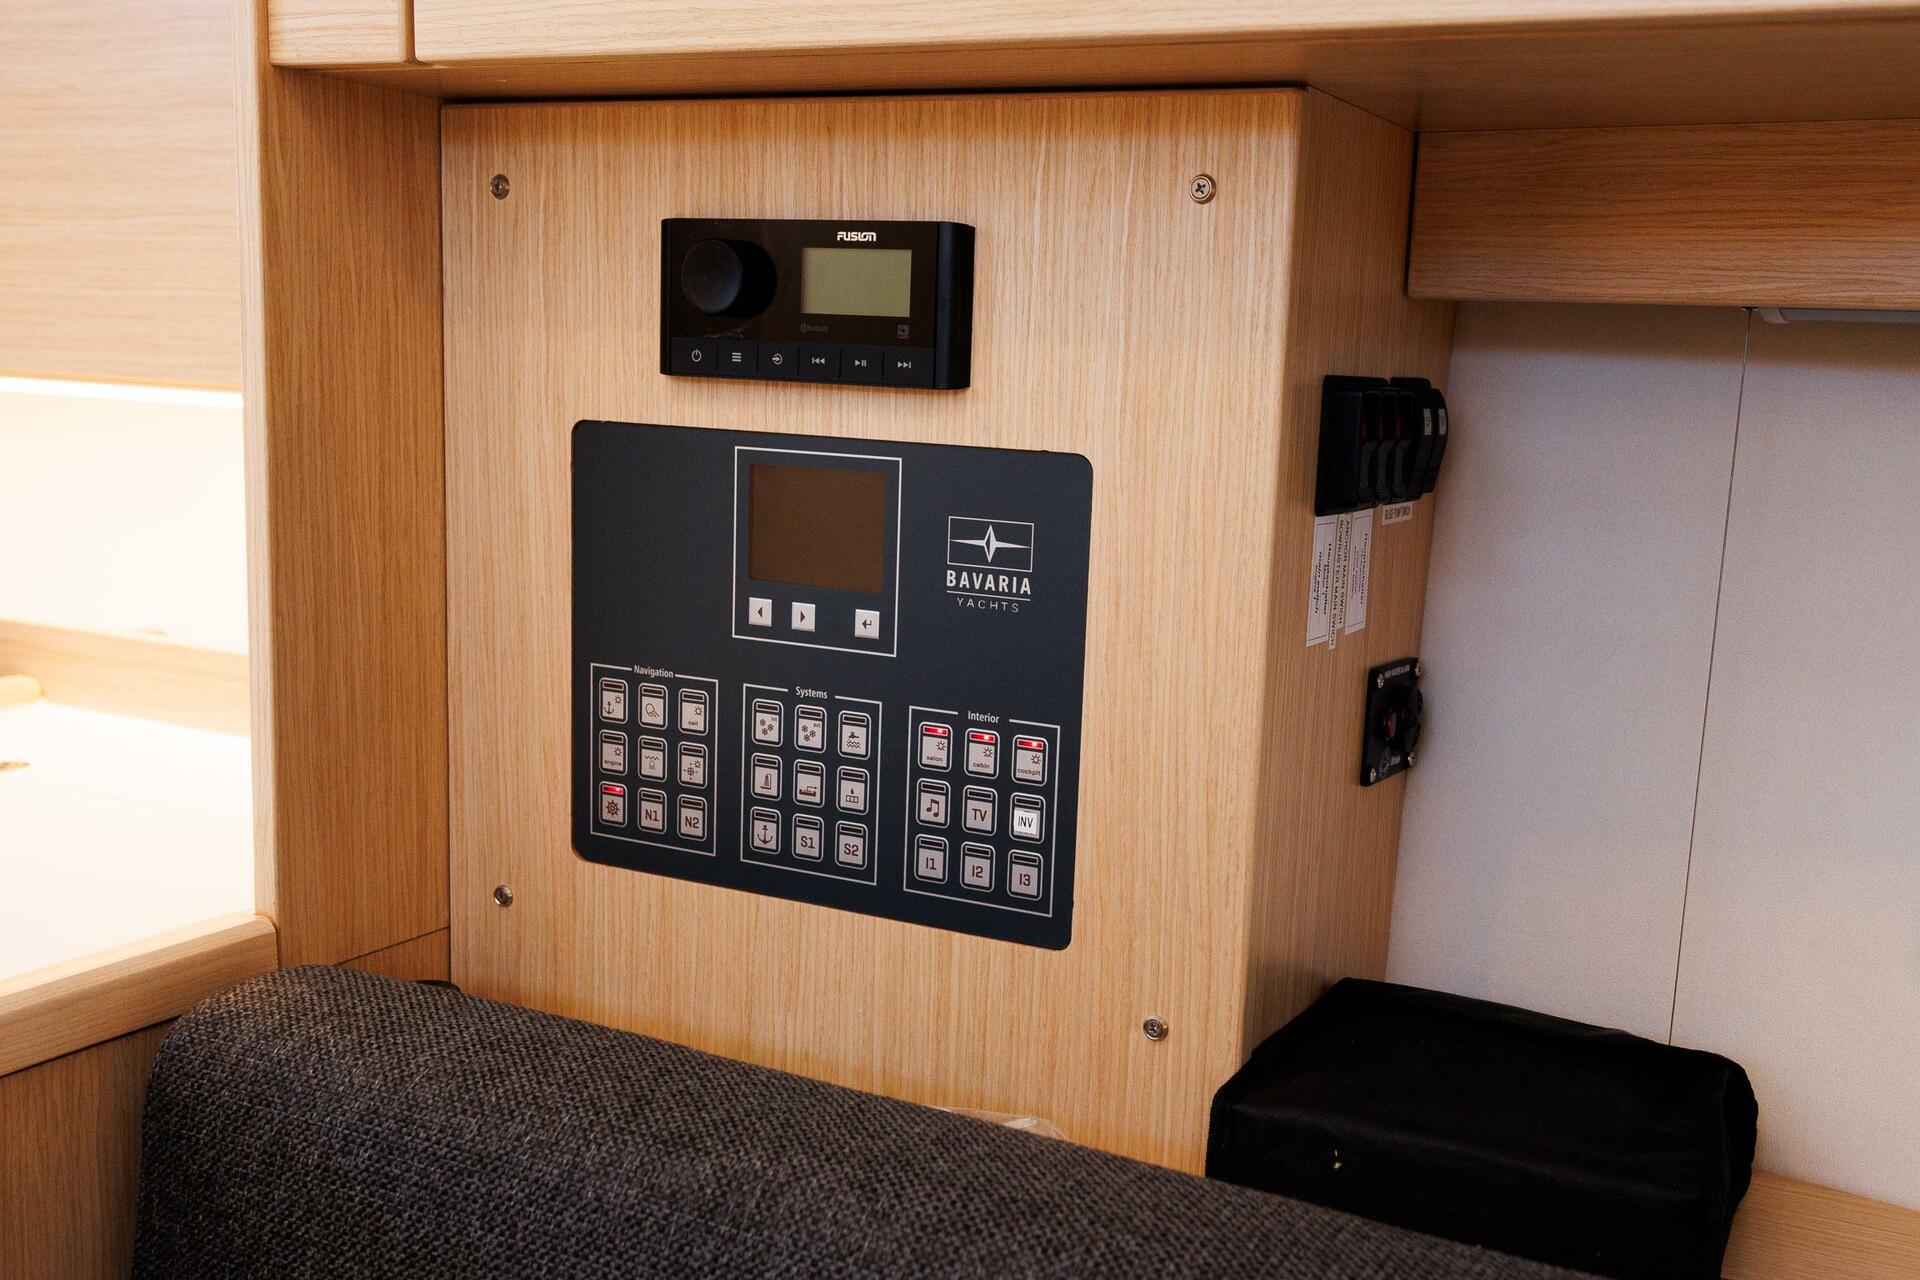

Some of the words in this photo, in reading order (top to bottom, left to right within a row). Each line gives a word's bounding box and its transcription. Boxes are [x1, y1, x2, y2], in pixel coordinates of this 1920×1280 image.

[836, 231, 877, 242] FUSION
[946, 569, 1032, 595] BAVARIA
[956, 597, 1020, 613] YACHTS
[633, 664, 674, 679] Navigation
[795, 686, 828, 700] Systems
[967, 710, 1000, 724] Interior
[604, 759, 622, 768] engine
[926, 754, 944, 763] salon
[972, 762, 991, 770] cabin
[1017, 767, 1041, 777] cockpit
[645, 808, 660, 823] N1
[971, 808, 988, 822] TV
[1017, 815, 1034, 829] INV
[684, 815, 700, 830] N2
[800, 835, 815, 850] S1
[843, 843, 859, 857] S2
